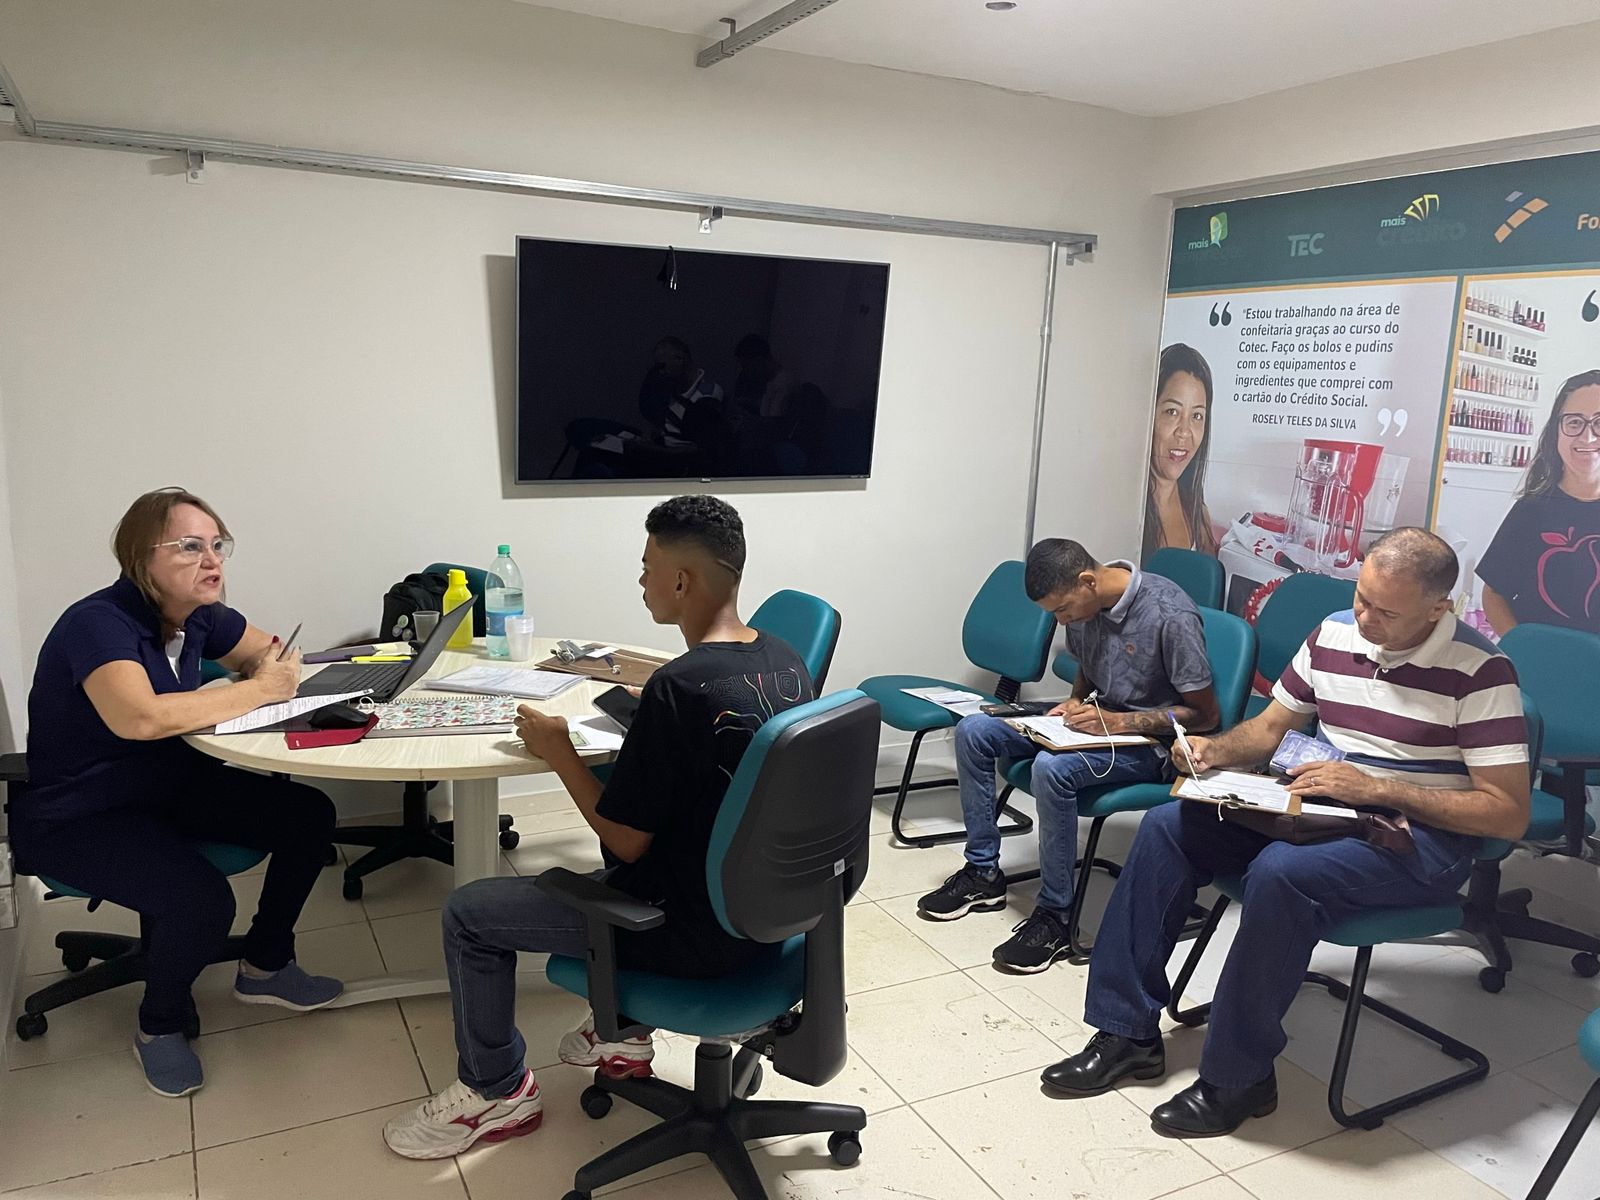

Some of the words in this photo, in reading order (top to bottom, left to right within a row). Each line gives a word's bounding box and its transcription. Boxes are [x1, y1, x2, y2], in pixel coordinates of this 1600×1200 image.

[1380, 214, 1407, 227] mais
[1576, 213, 1600, 230] Fo
[1188, 237, 1209, 250] mais
[1288, 233, 1325, 257] TEC
[1275, 305, 1336, 319] trabalhando
[1340, 306, 1353, 317] na
[1356, 303, 1382, 316] área
[1385, 302, 1400, 315] de
[1240, 323, 1292, 336] confeitaria
[1295, 324, 1329, 338] graças
[1333, 324, 1346, 335] ao
[1349, 323, 1381, 335] curso
[1384, 321, 1399, 334] do
[1238, 341, 1268, 353] Cotec.
[1271, 341, 1295, 355] Faço
[1298, 343, 1310, 353] os
[1313, 340, 1341, 353] bolos
[1345, 343, 1351, 353] e
[1355, 340, 1393, 355] pudins
[1236, 360, 1257, 369] com
[1259, 360, 1271, 369] os
[1273, 358, 1346, 372] equipamentos
[1350, 361, 1356, 371] e
[1235, 373, 1295, 388] ingredientes
[1297, 377, 1317, 389] que
[1320, 377, 1365, 391] comprei
[1368, 379, 1393, 390] com
[1233, 393, 1239, 402] o
[1241, 392, 1272, 403] cartão
[1274, 392, 1287, 404] do
[1290, 392, 1328, 406] Crédito
[1331, 393, 1368, 407] Social.
[1252, 413, 1285, 425] ROSELY
[1286, 415, 1313, 427] TELES
[1315, 417, 1327, 428] DA
[1330, 418, 1356, 430] SILVA
